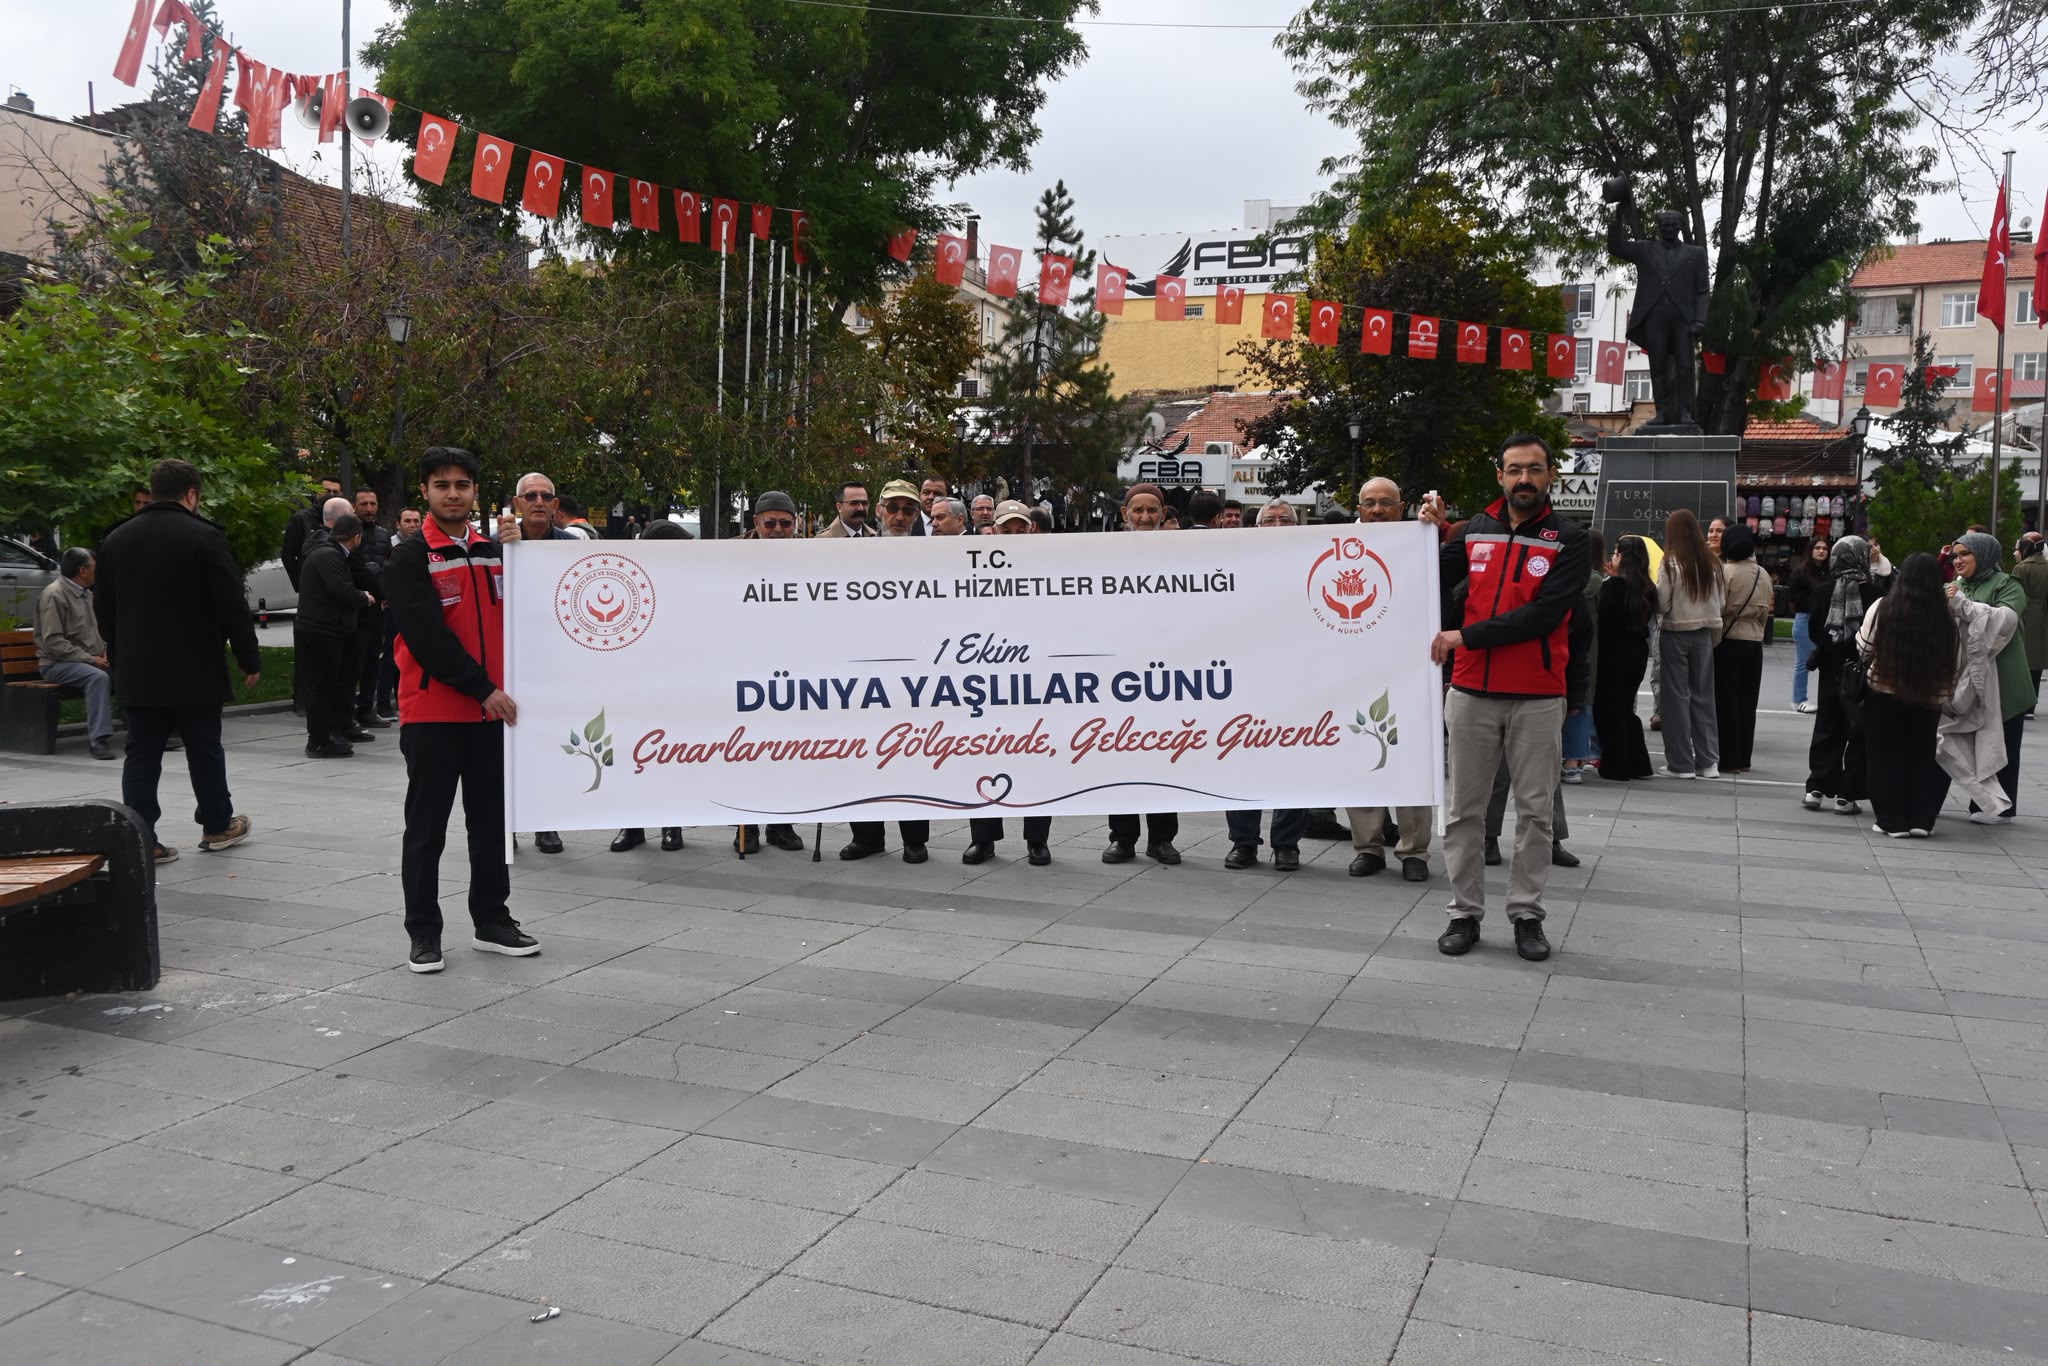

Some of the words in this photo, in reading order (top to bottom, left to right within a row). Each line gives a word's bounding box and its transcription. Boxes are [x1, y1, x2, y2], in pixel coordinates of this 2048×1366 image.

[1194, 237, 1309, 270] FBA
[1226, 275, 1261, 283] STORE
[1139, 461, 1202, 477] FBA
[1233, 467, 1254, 483] ALİ
[967, 550, 1012, 569] T.C.
[1332, 537, 1365, 560] 10
[743, 578, 798, 602] AİLE
[806, 582, 838, 601] VE
[846, 579, 947, 600] SOSYAL
[955, 574, 1093, 598] HİZMETLER
[1101, 569, 1234, 594] BAKANLIĞI
[1326, 621, 1336, 630] VE
[1338, 626, 1363, 635] NÜFUS
[1366, 620, 1377, 630] ON
[933, 638, 950, 665] 1
[955, 633, 1031, 665] Ekim
[736, 671, 891, 712] DÜNYA
[901, 672, 1099, 718] YAŞLILAR
[1111, 660, 1232, 702] GÜNÜ
[633, 725, 868, 774] Çınarlarımızın
[876, 718, 1057, 769] Gölgesinde,
[1070, 716, 1208, 764] Geleceğe
[1217, 710, 1341, 760] Güvenle
